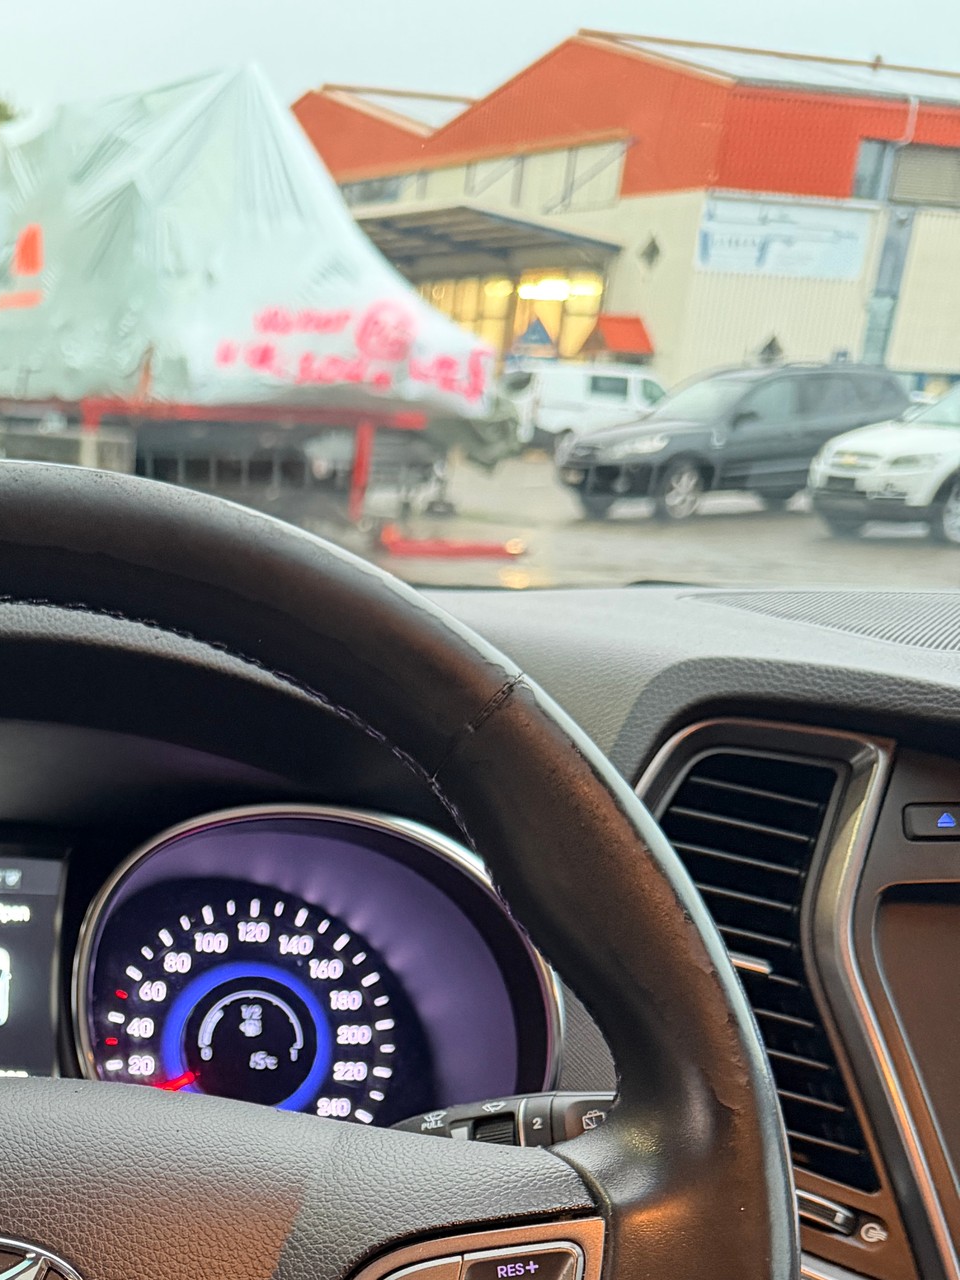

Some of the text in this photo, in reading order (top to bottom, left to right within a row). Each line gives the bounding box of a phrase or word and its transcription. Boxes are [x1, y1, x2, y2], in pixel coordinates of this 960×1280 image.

[194, 932, 228, 954] 100
[238, 922, 270, 943] 120
[278, 934, 314, 956] 140
[163, 952, 191, 974] 80
[309, 959, 344, 980] 160
[139, 981, 167, 1002] 60
[330, 990, 362, 1011] 180
[127, 1017, 154, 1039] 40
[337, 1024, 372, 1045] 200
[128, 1055, 155, 1077] 20
[333, 1061, 367, 1082] 220
[317, 1097, 351, 1118] 240
[532, 1117, 542, 1130] 2
[497, 1260, 539, 1279] RES+
